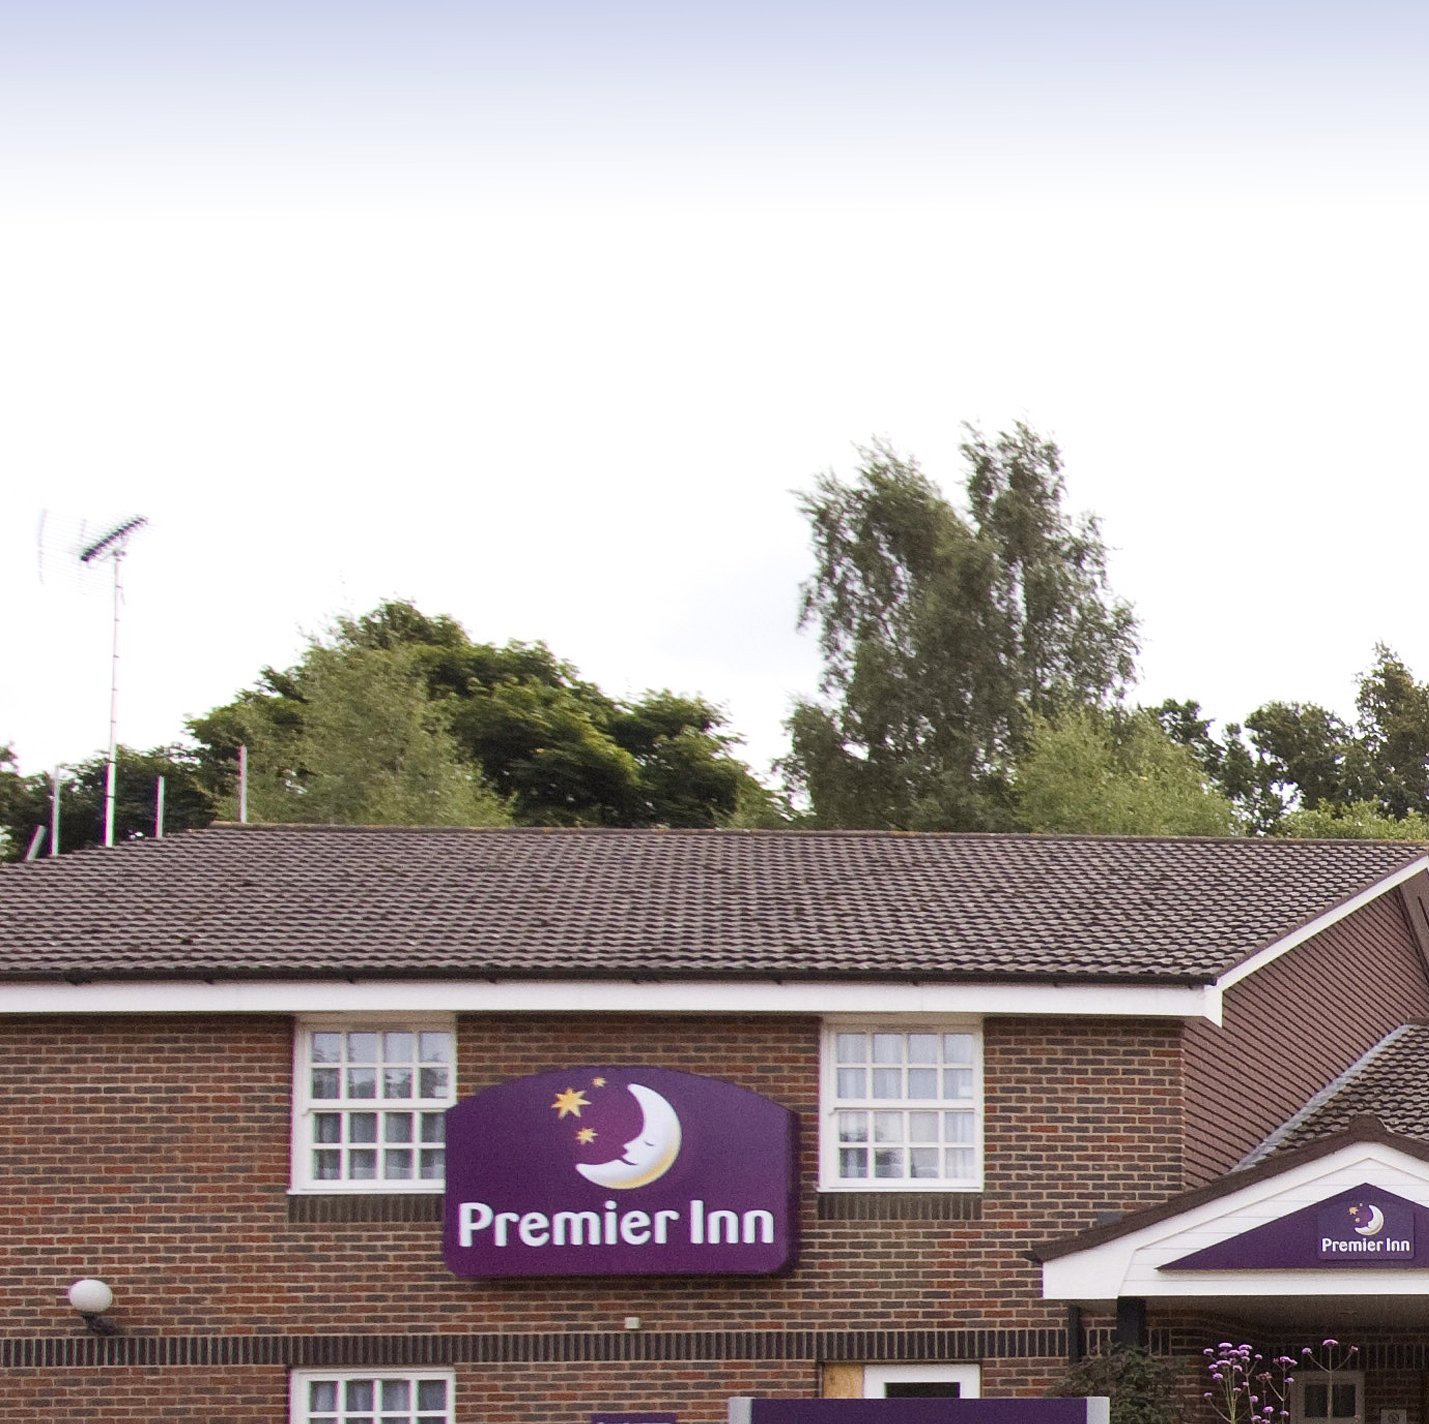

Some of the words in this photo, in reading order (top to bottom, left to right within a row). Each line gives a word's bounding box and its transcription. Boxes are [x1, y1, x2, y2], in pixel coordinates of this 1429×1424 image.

[458, 1199, 681, 1247] Premier
[689, 1199, 775, 1244] Inn
[1321, 1237, 1384, 1252] Premier
[1386, 1237, 1410, 1252] Inn
